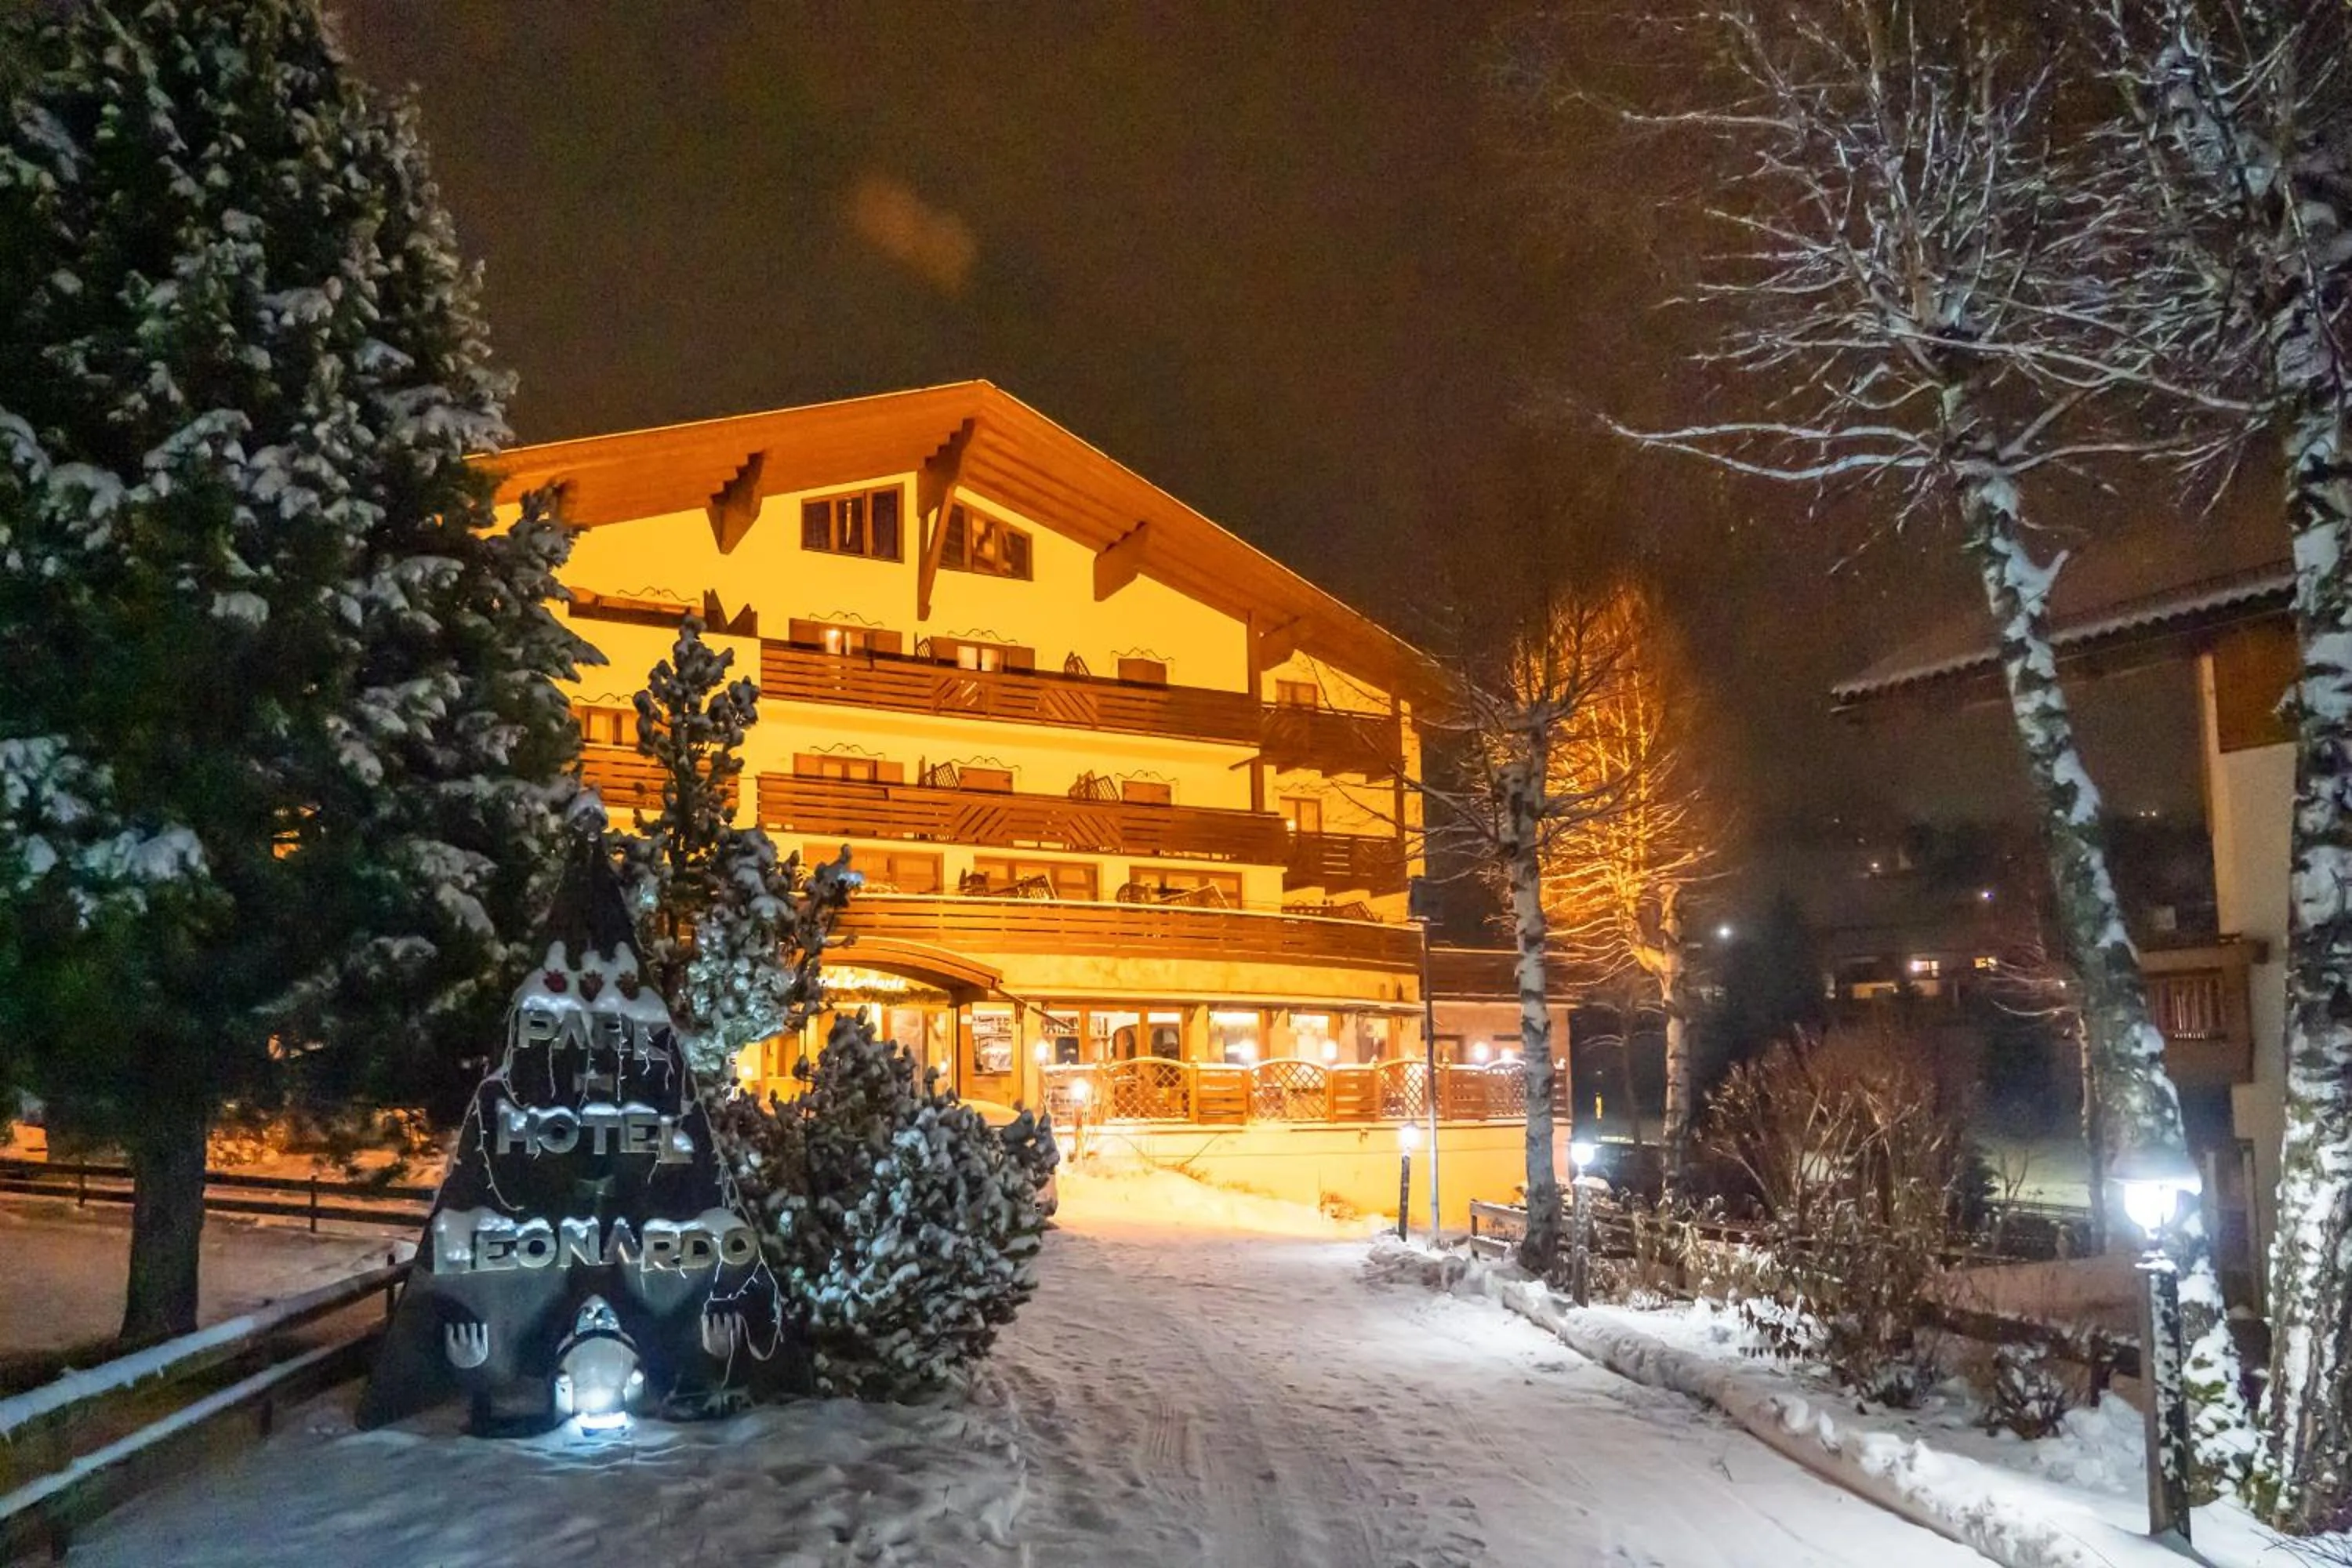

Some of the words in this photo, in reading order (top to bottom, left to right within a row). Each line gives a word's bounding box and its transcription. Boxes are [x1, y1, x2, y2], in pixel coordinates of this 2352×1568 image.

[517, 1009, 672, 1061] PARK
[496, 1110, 695, 1164] HOTEL
[434, 1221, 757, 1275] LEONARDO
